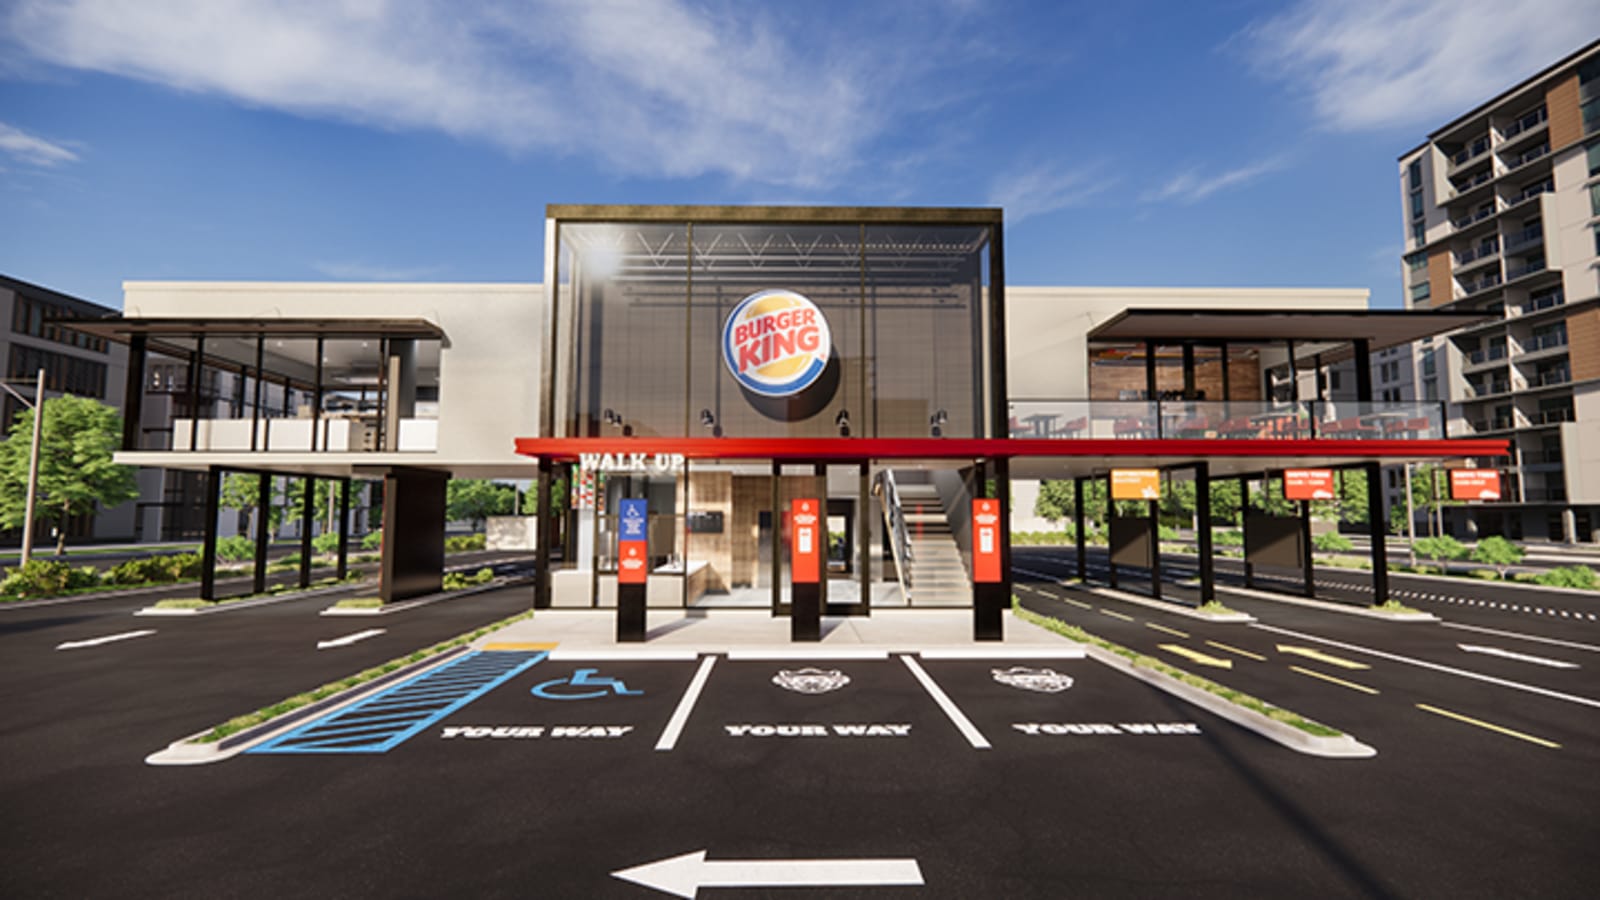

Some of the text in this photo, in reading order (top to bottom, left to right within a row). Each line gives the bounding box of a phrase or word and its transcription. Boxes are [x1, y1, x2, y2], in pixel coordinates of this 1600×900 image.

[735, 308, 816, 345] BURGER
[738, 326, 820, 373] KING
[579, 453, 685, 471] WALK UP
[440, 725, 634, 738] YOUR WAY
[724, 724, 912, 736] YOUR WAY
[1011, 722, 1202, 735] YOUR WAY
